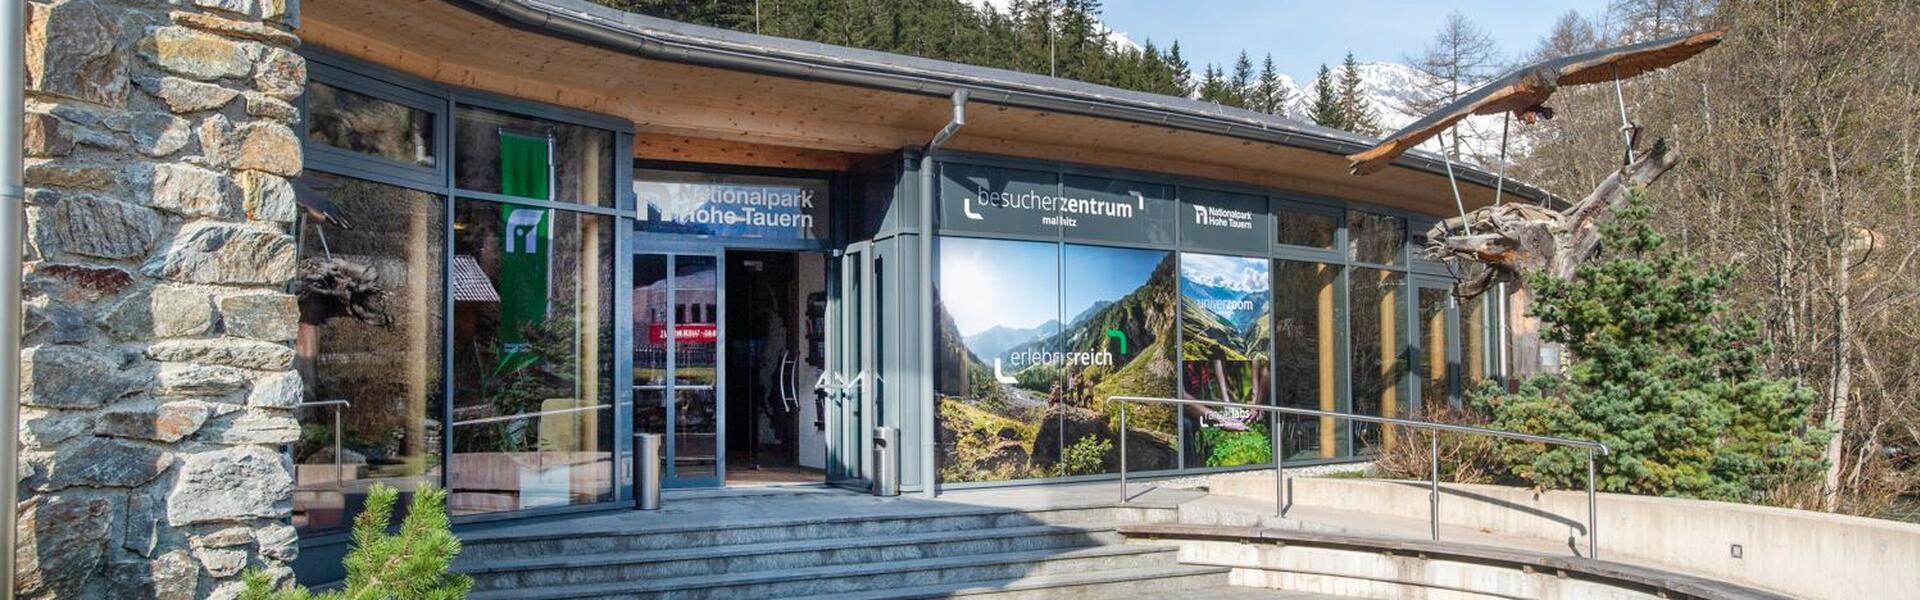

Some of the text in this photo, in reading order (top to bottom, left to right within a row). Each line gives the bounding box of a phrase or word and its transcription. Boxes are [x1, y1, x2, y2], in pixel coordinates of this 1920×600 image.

[977, 185, 1133, 218] besucherzentrum
[742, 207, 814, 228] Tauern
[1208, 206, 1253, 220] Nationalpark
[1208, 216, 1253, 229] Hohe Tauern
[1010, 347, 1113, 366] erlebnsreich
